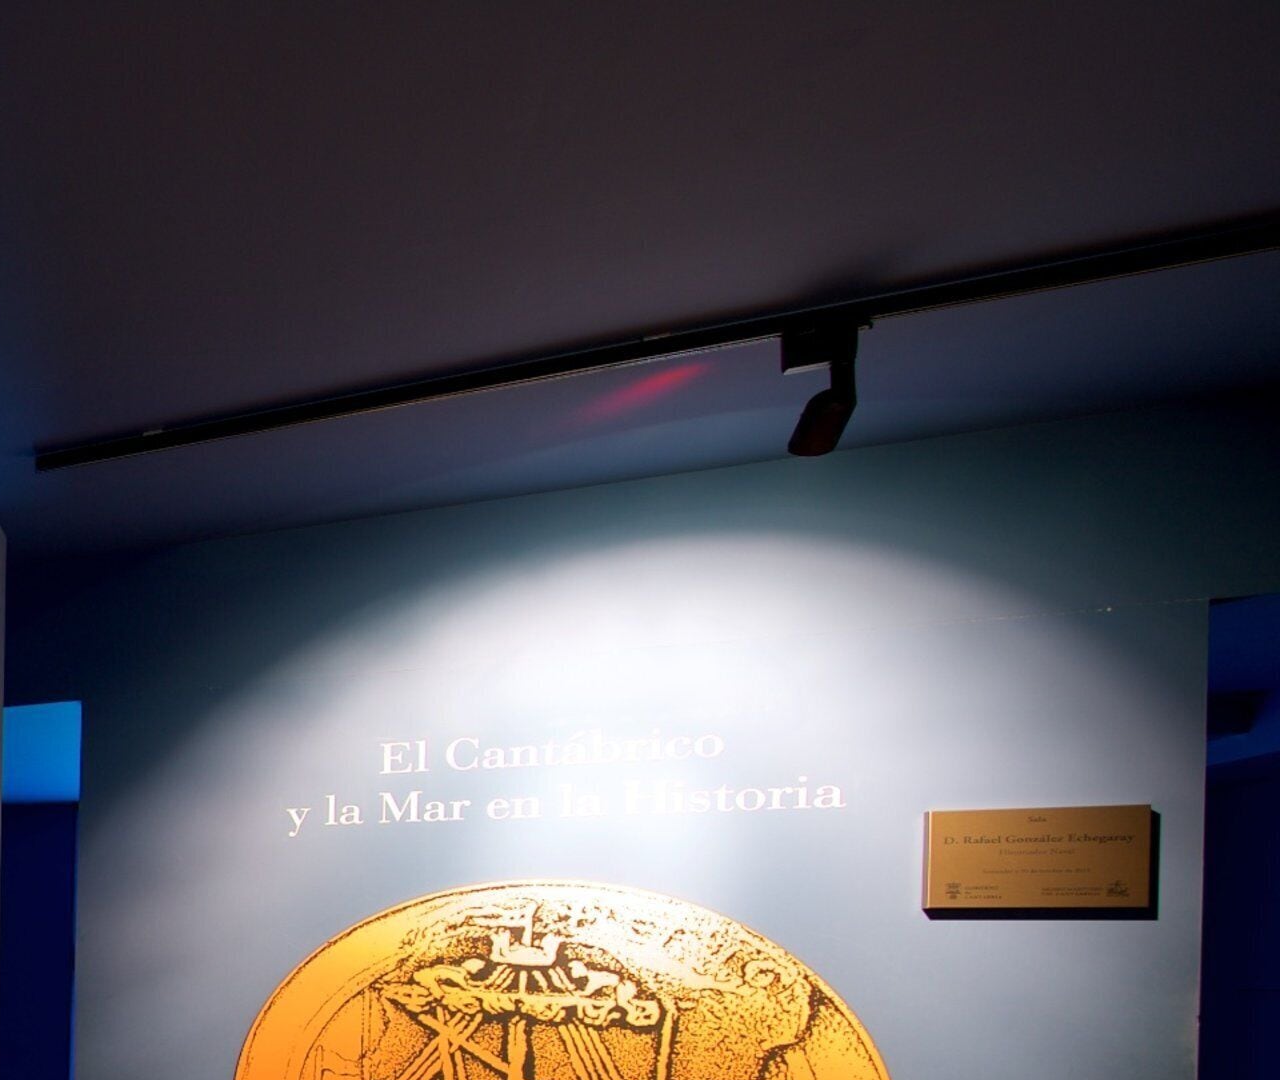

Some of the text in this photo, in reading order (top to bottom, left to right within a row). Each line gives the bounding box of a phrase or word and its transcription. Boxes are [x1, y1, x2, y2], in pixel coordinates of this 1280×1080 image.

[379, 727, 726, 776] El Cantábrico
[286, 775, 848, 837] y la Mar en la Historia
[1027, 815, 1048, 823] Sala
[943, 832, 1136, 847] D. Rafael González Echegaray
